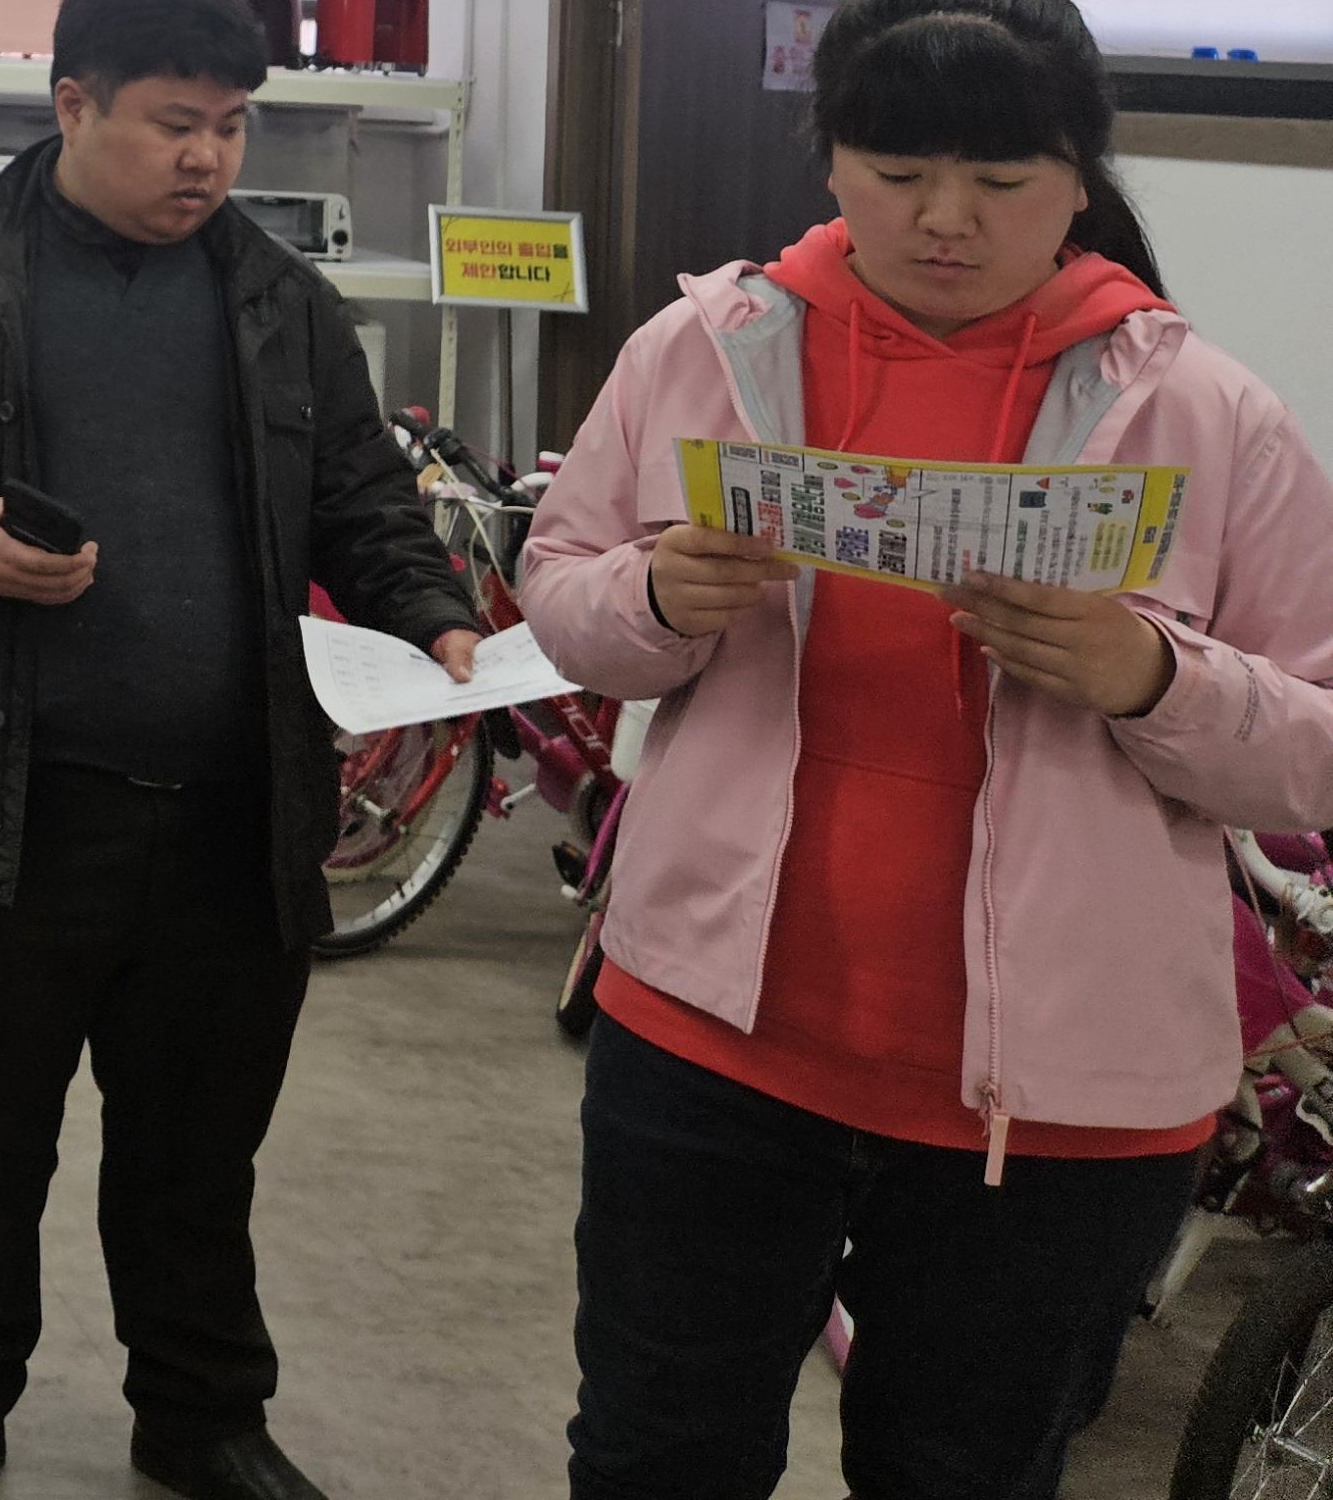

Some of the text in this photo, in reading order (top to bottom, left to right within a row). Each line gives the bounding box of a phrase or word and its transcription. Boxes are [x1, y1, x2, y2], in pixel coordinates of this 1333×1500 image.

[445, 238, 569, 260] 외부인의 출입을
[461, 261, 551, 282] 제한합니다
